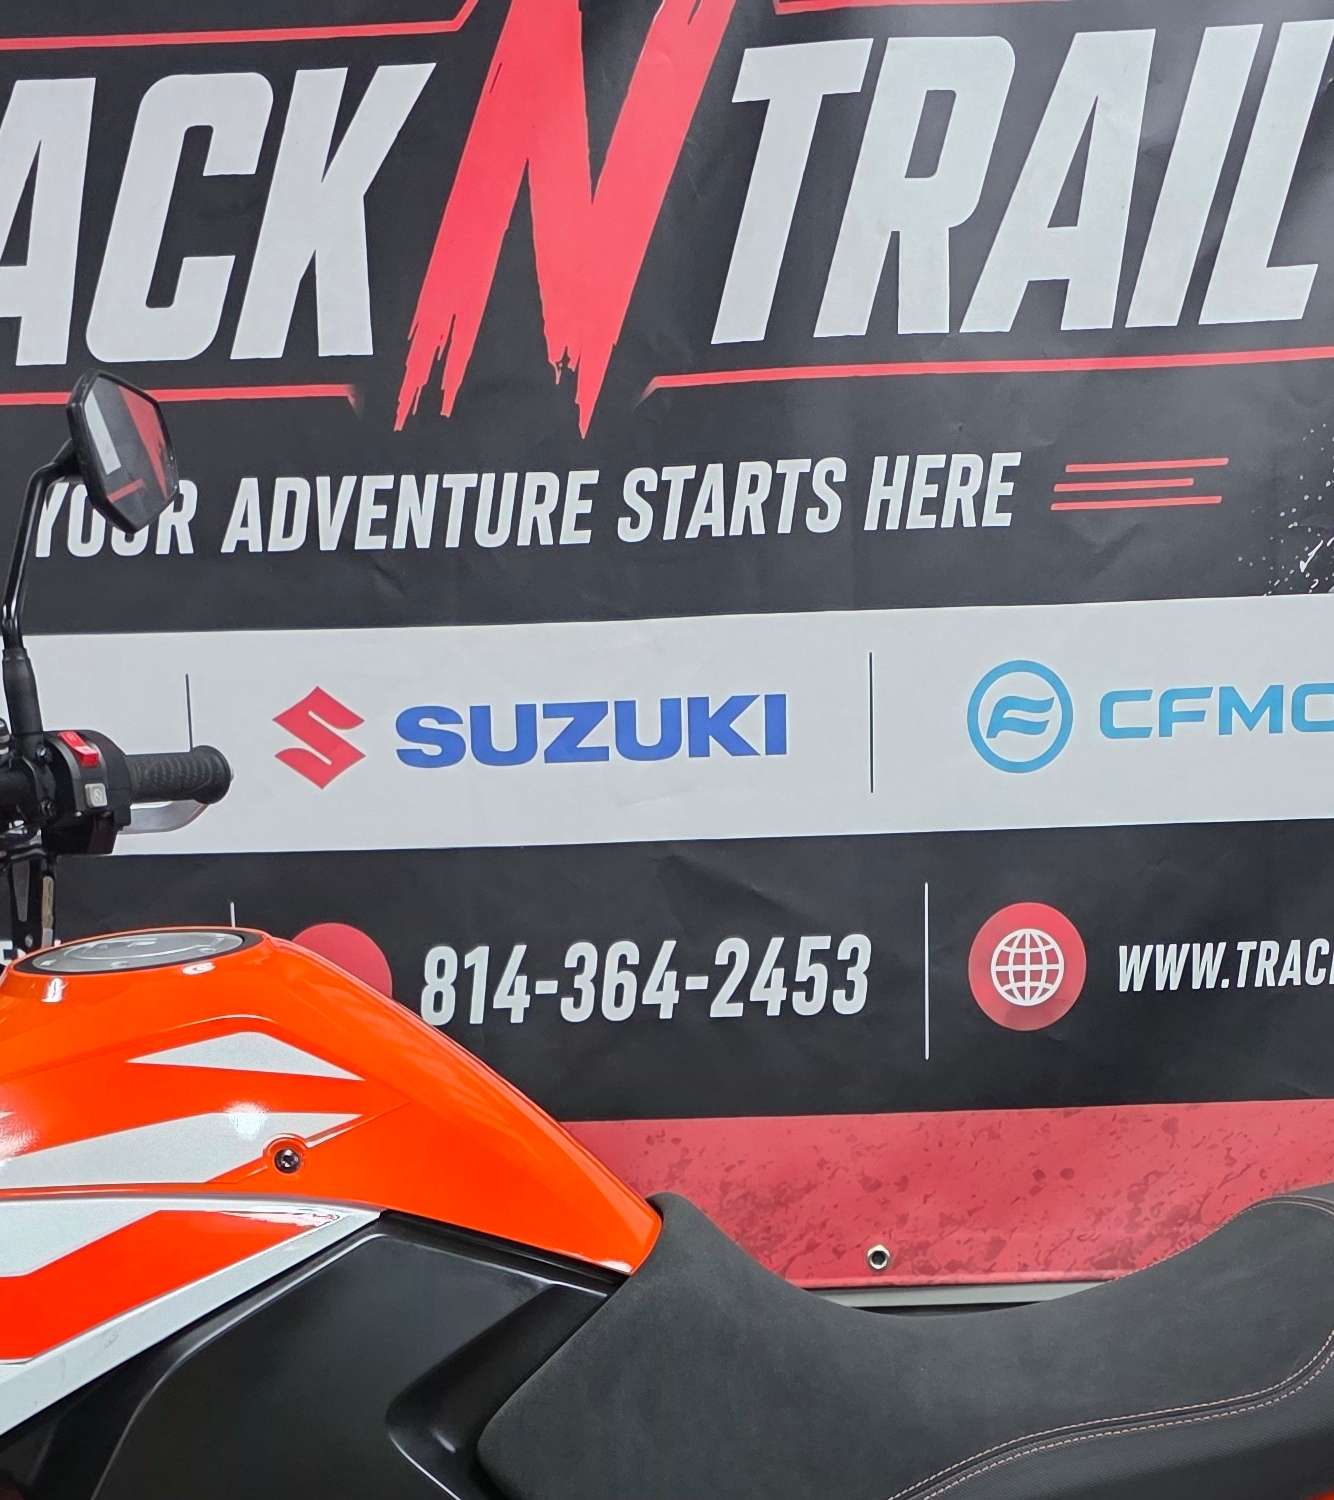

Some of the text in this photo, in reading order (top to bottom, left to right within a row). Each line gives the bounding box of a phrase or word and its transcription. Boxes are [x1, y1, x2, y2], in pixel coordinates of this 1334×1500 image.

[395, 0, 731, 438] N
[221, 469, 599, 553] ADVENTURE
[617, 457, 847, 543] STARTS
[864, 451, 1023, 532] HERE
[395, 693, 788, 769] SUZUKI
[420, 933, 872, 1026] 814-364-2453
